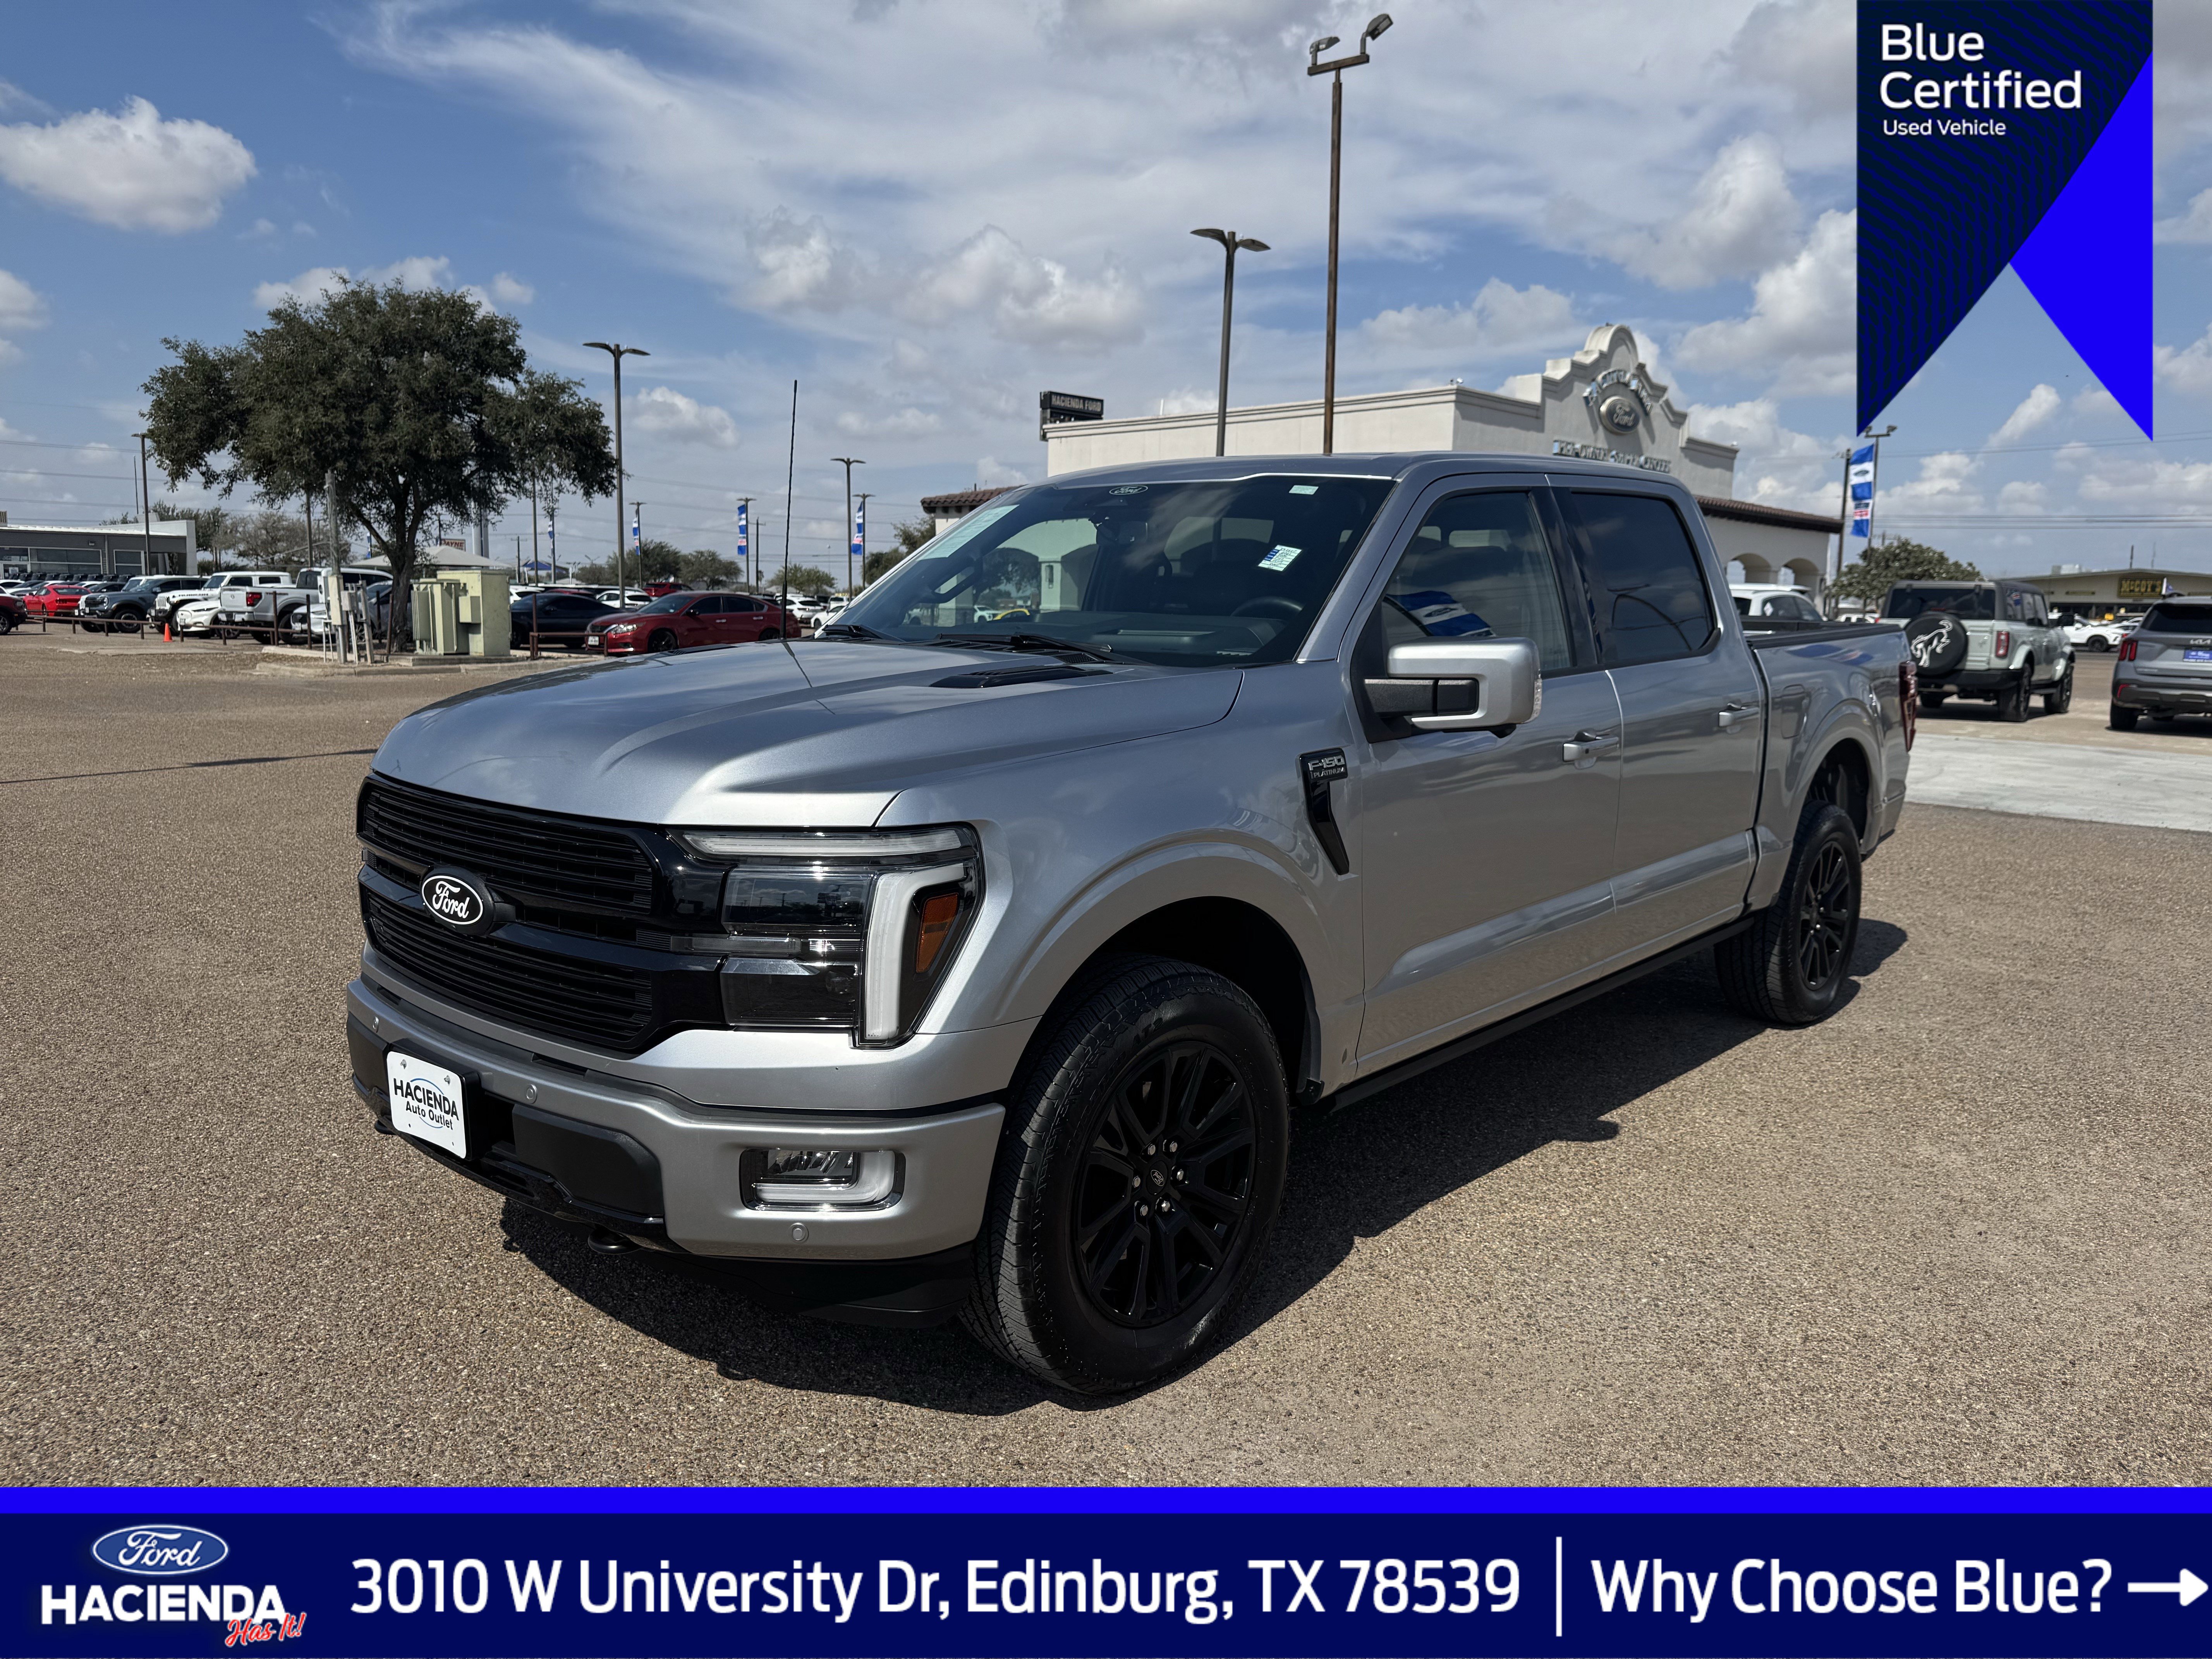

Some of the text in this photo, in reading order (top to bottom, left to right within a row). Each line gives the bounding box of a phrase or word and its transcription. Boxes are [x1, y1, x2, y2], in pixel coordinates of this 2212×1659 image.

[1051, 395, 1102, 412] HACIENDA FORD
[1308, 755, 1345, 771] F-150
[1313, 767, 1345, 778] PLATINUM
[431, 880, 472, 919] Ford
[393, 1078, 459, 1121] HACIENDA
[405, 1101, 453, 1130] Auto Outlet
